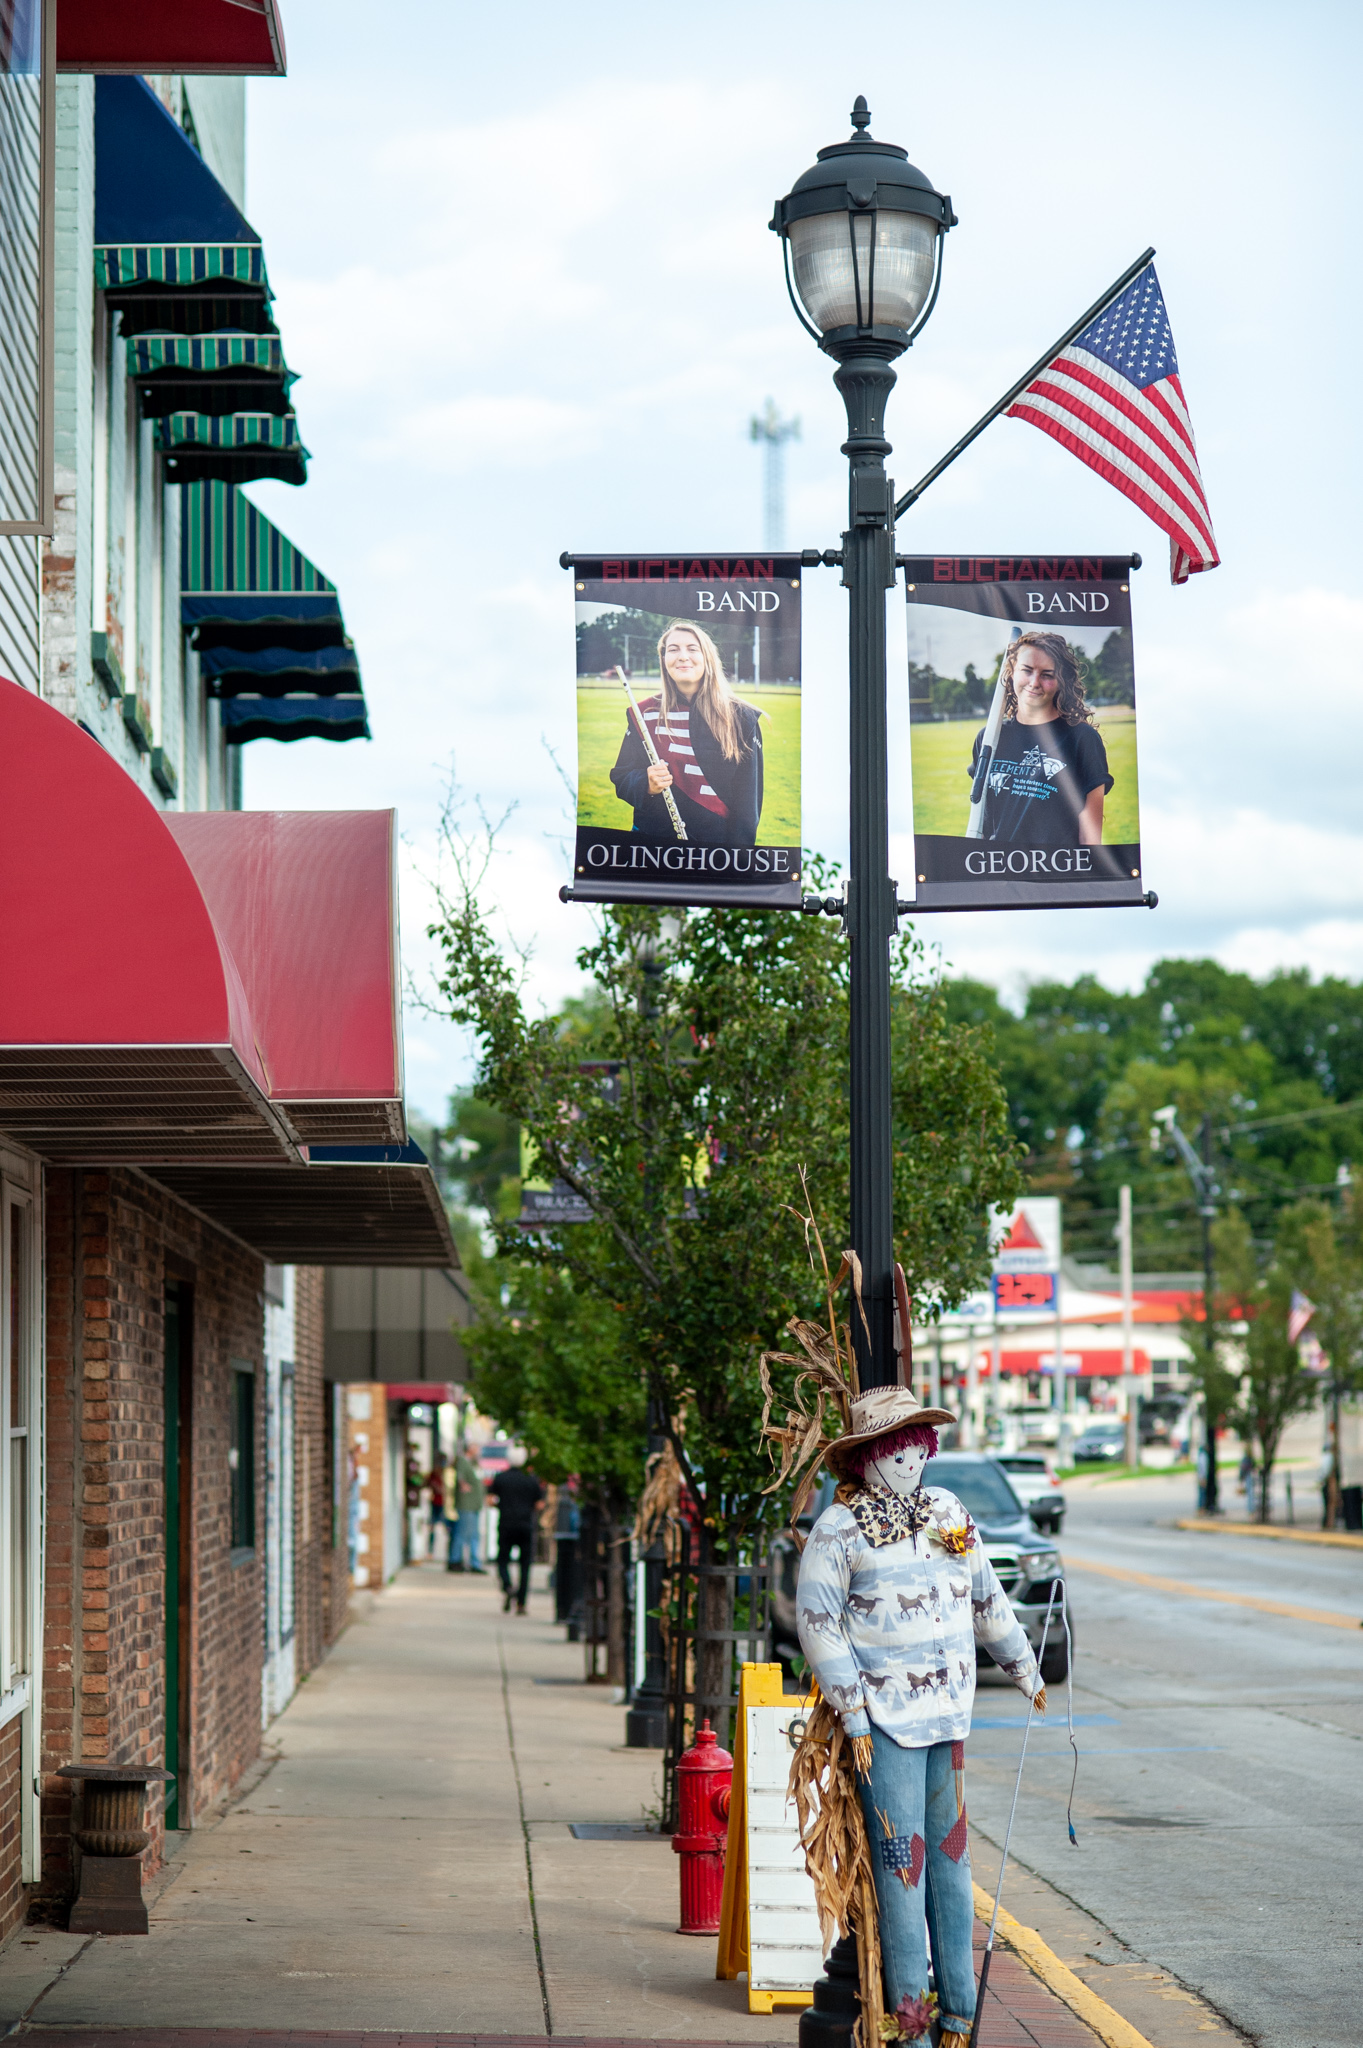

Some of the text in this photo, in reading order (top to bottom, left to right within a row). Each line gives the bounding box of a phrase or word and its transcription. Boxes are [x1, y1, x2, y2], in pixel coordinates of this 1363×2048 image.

[602, 559, 774, 584] BUCHANAN
[933, 557, 1104, 582] BUCHANAN
[696, 590, 781, 613] BAND
[1026, 591, 1110, 614] BAND
[586, 843, 791, 874] OLINGHOUSE
[964, 848, 1093, 875] GEORGE
